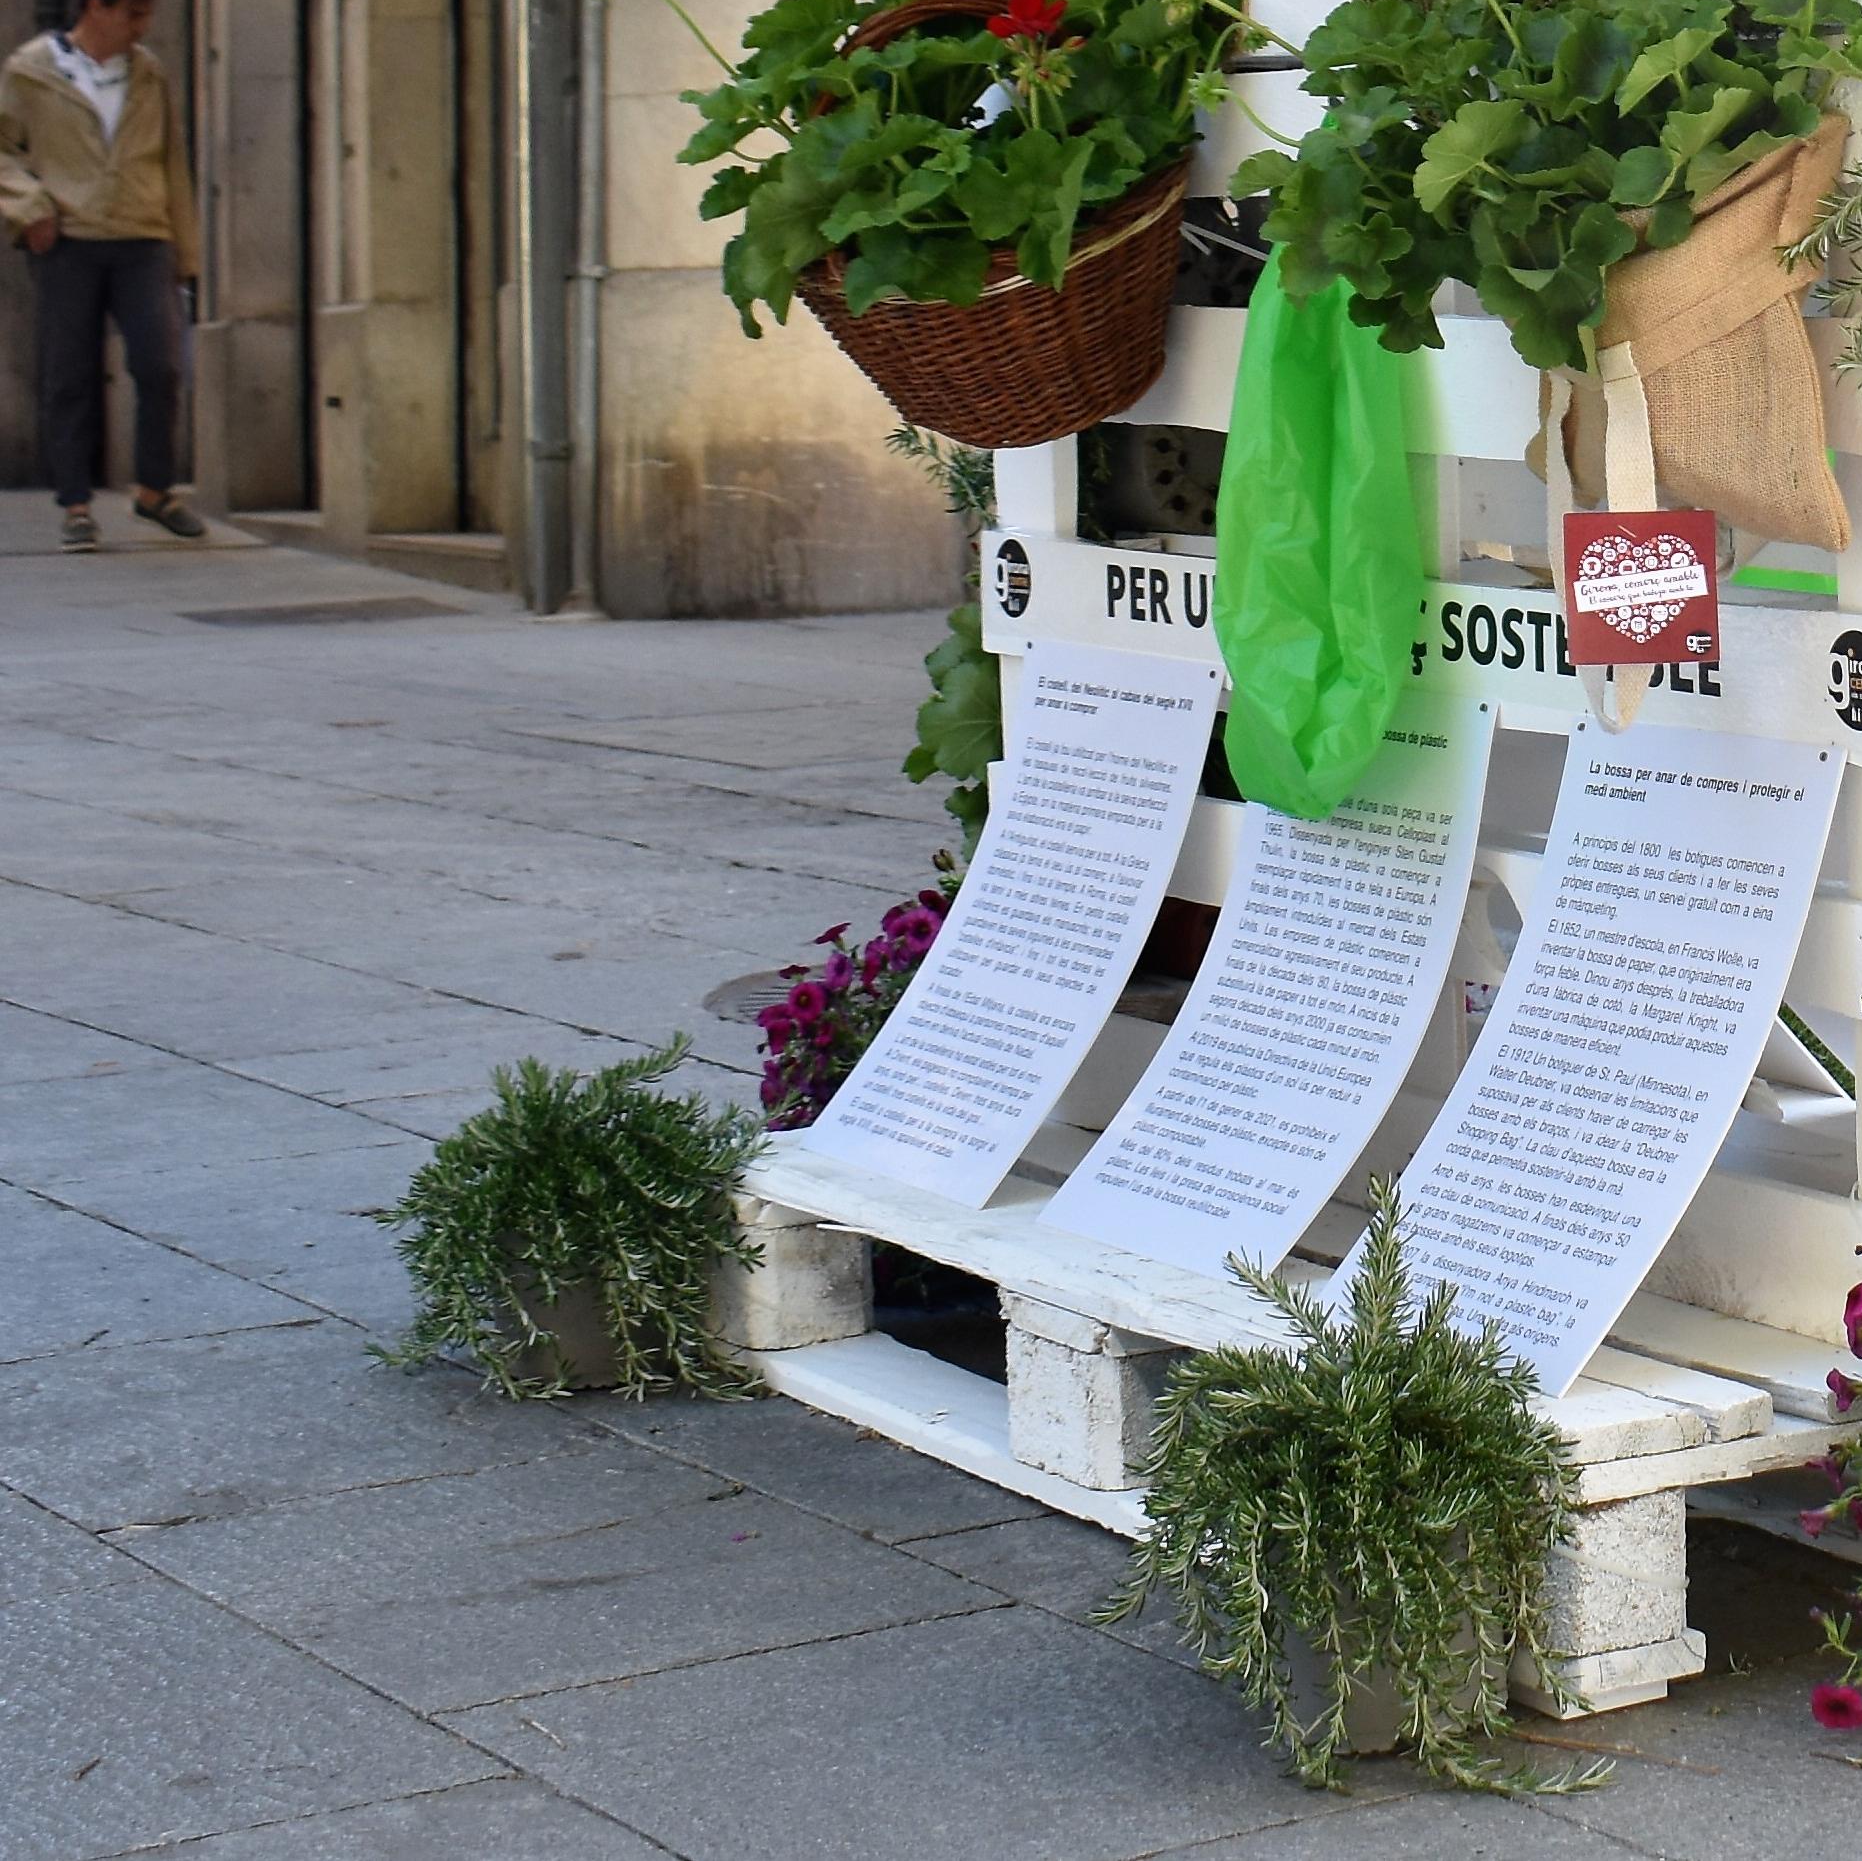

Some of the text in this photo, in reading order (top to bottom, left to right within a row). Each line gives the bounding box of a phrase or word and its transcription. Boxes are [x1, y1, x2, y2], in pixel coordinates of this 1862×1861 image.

[1106, 564, 1174, 625] PER
[1183, 571, 1217, 629] U
[1584, 783, 1647, 803] medi ambient
[1589, 759, 1601, 775] La
[1604, 762, 1633, 779] bossa
[1634, 769, 1653, 784] per
[1654, 771, 1678, 784] anar
[1680, 771, 1693, 787] de
[1696, 776, 1740, 794] compres
[1748, 783, 1791, 803] protegir
[1793, 788, 1805, 802] el
